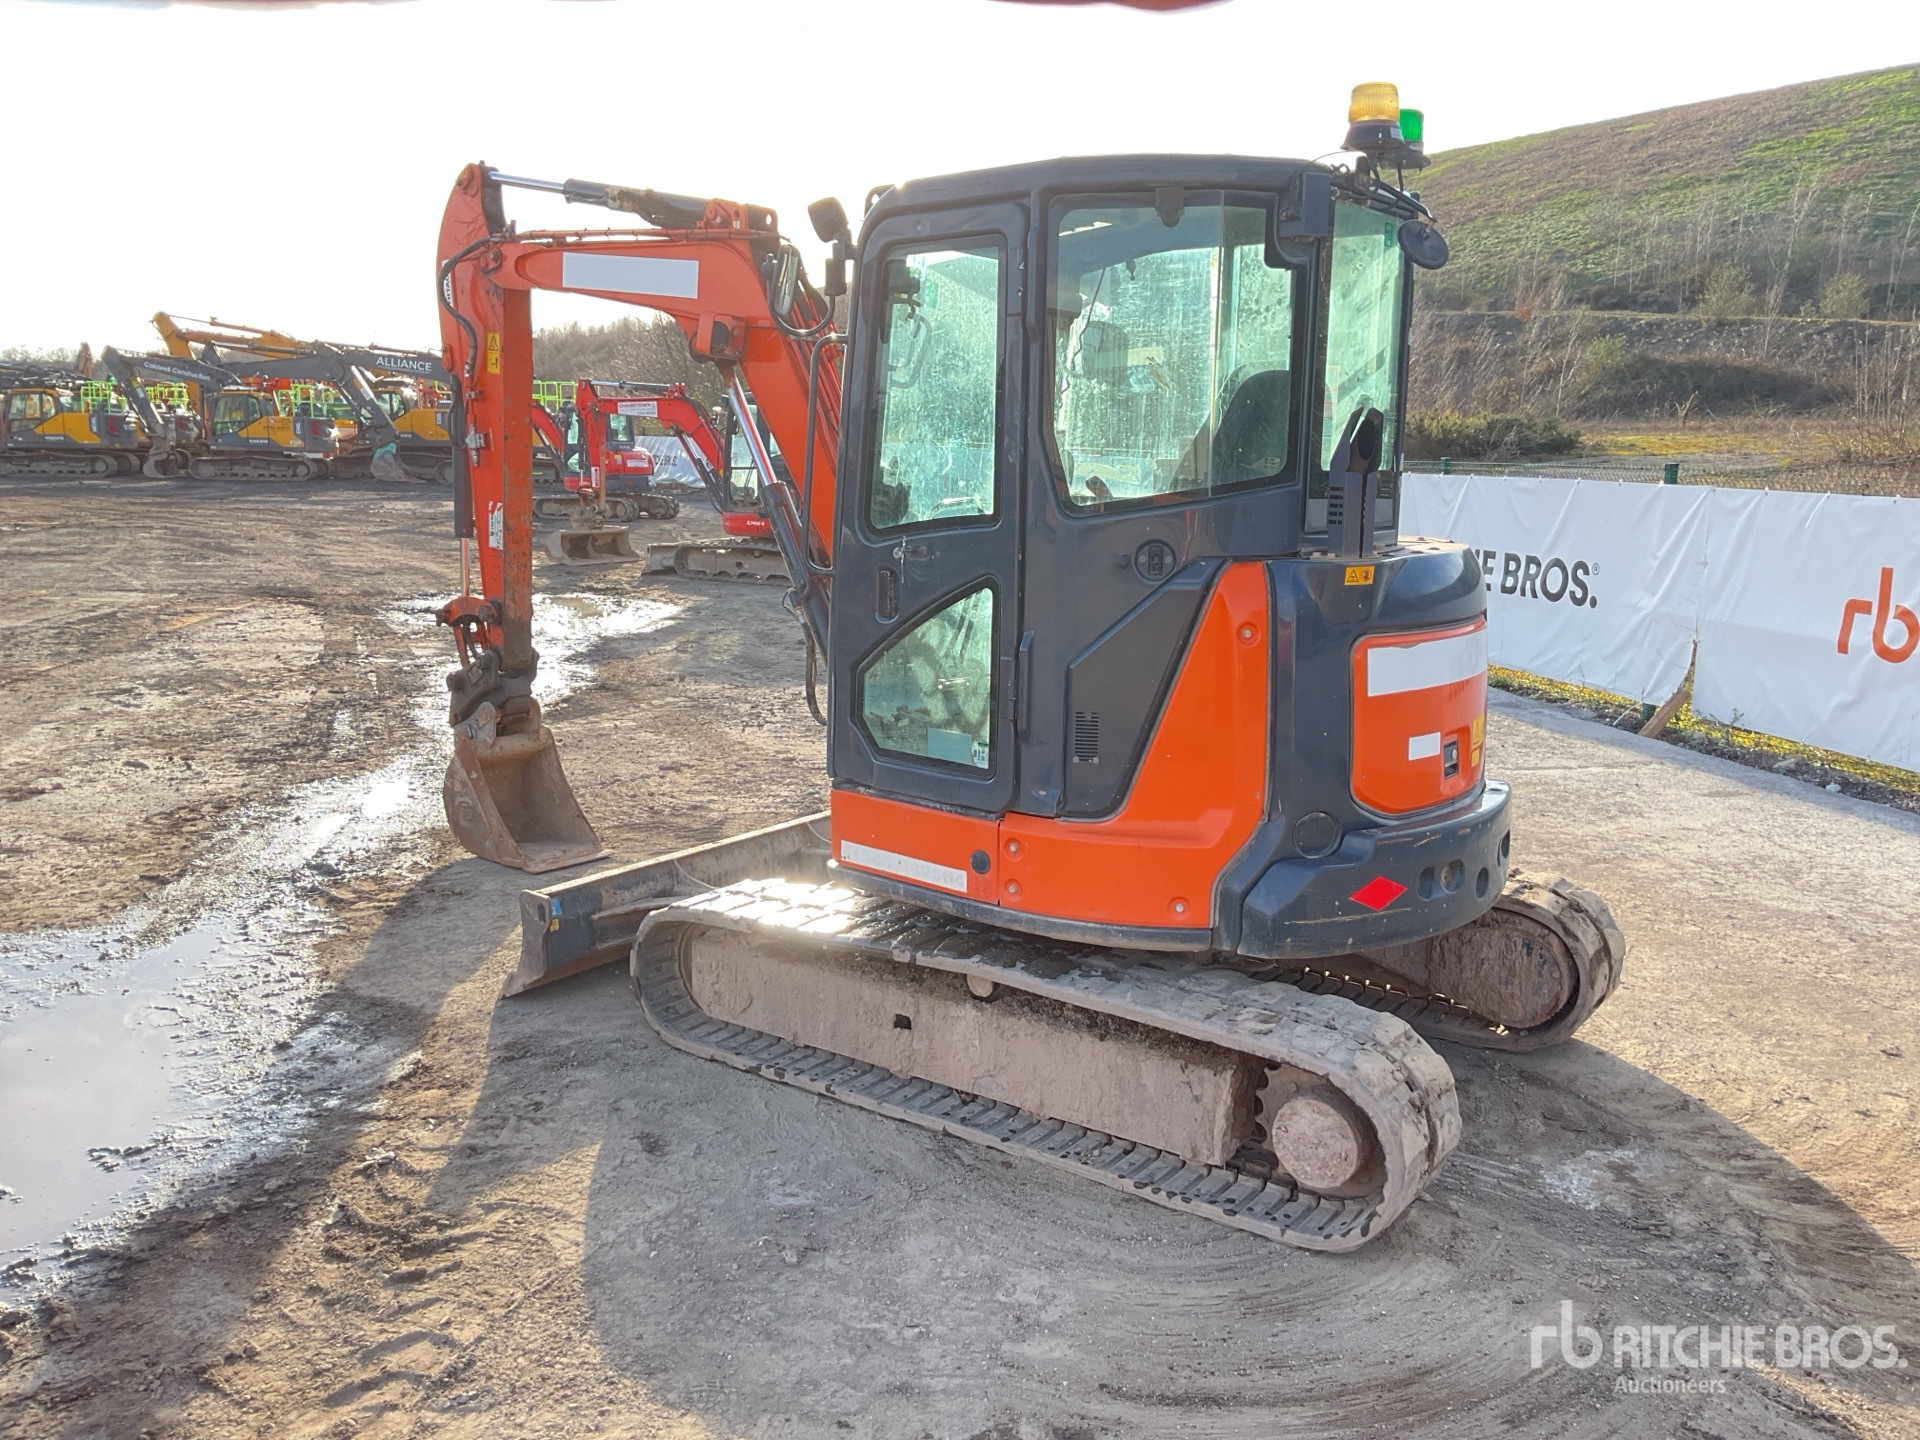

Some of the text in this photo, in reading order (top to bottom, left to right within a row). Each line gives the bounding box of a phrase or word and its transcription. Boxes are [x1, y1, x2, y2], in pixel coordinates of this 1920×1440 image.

[375, 356, 432, 372] ALLIANCE
[171, 366, 211, 381] Construction
[1837, 566, 1920, 664] rb
